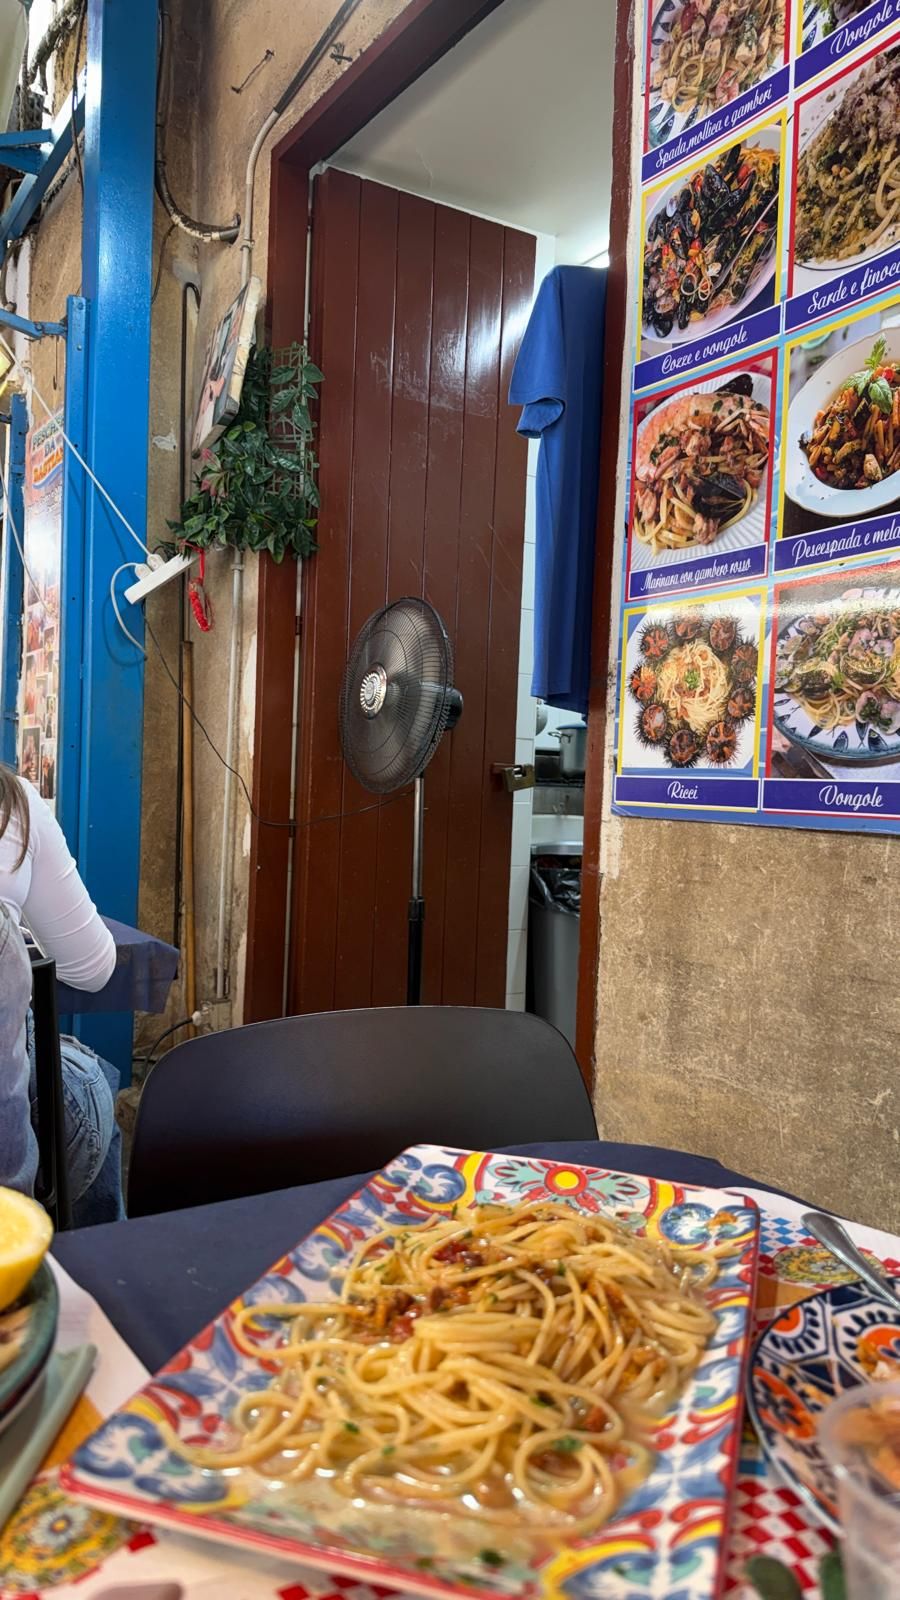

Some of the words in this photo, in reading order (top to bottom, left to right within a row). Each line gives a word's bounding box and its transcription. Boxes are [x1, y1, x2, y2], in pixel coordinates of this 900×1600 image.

[830, 0, 893, 55] Vongole
[724, 115, 730, 127] e
[731, 84, 773, 129] gamberi
[807, 280, 848, 314] Sarde
[850, 281, 858, 295] e
[661, 354, 693, 374] Cozze
[695, 350, 701, 361] e
[702, 325, 748, 354] vongole
[791, 528, 863, 566] Pescespada
[864, 532, 871, 546] e
[640, 572, 679, 591] Marinara
[679, 571, 693, 584] con
[694, 559, 728, 584] gambero
[729, 558, 751, 574] rosso
[667, 781, 699, 800] Ricci
[819, 785, 884, 811] Vongole
